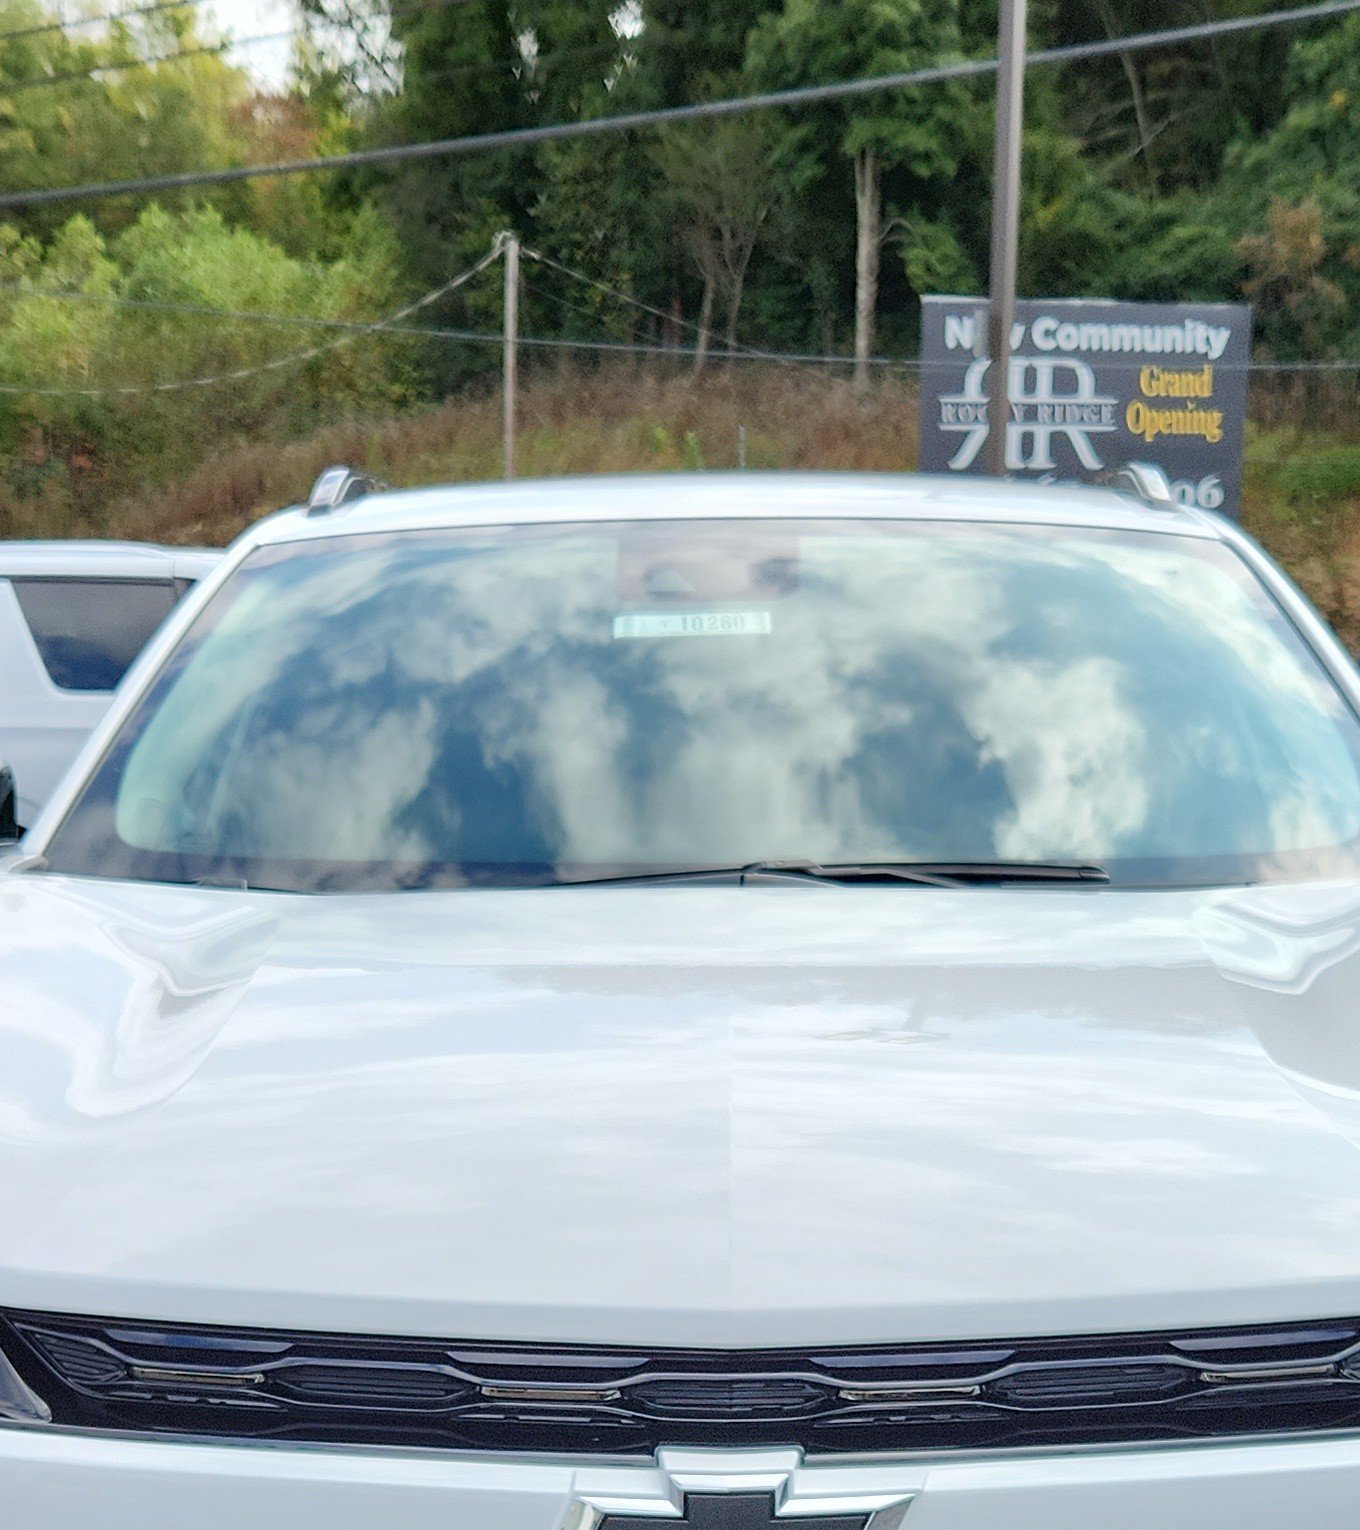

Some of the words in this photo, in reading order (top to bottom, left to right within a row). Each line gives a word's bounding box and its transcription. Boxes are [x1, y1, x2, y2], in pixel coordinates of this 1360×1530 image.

[1031, 316, 1231, 360] Community
[1140, 364, 1214, 397] Grand
[1037, 403, 1116, 425] RIDGE
[1126, 401, 1224, 443] Opening
